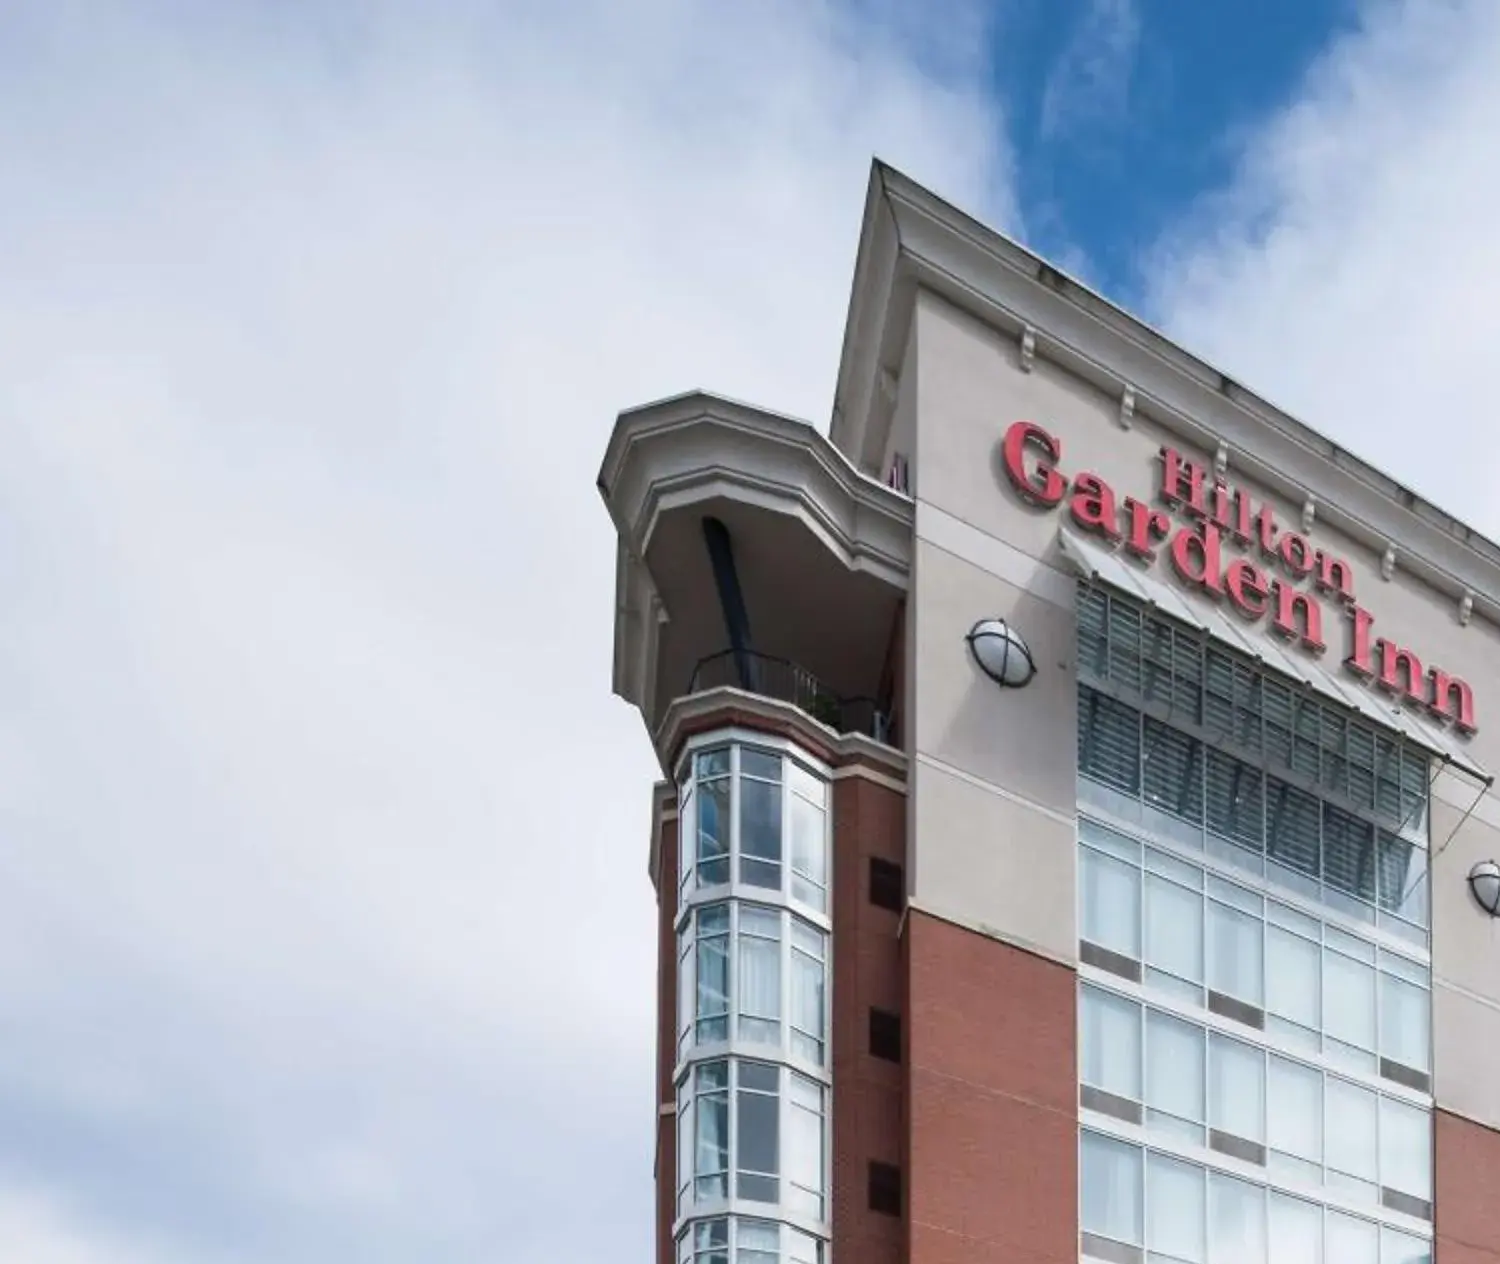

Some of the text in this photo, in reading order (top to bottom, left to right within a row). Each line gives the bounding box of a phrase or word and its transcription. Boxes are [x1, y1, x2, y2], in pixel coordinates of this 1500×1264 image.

[1003, 420, 1477, 735] Garden Inn
[1160, 445, 1356, 602] Hilton
